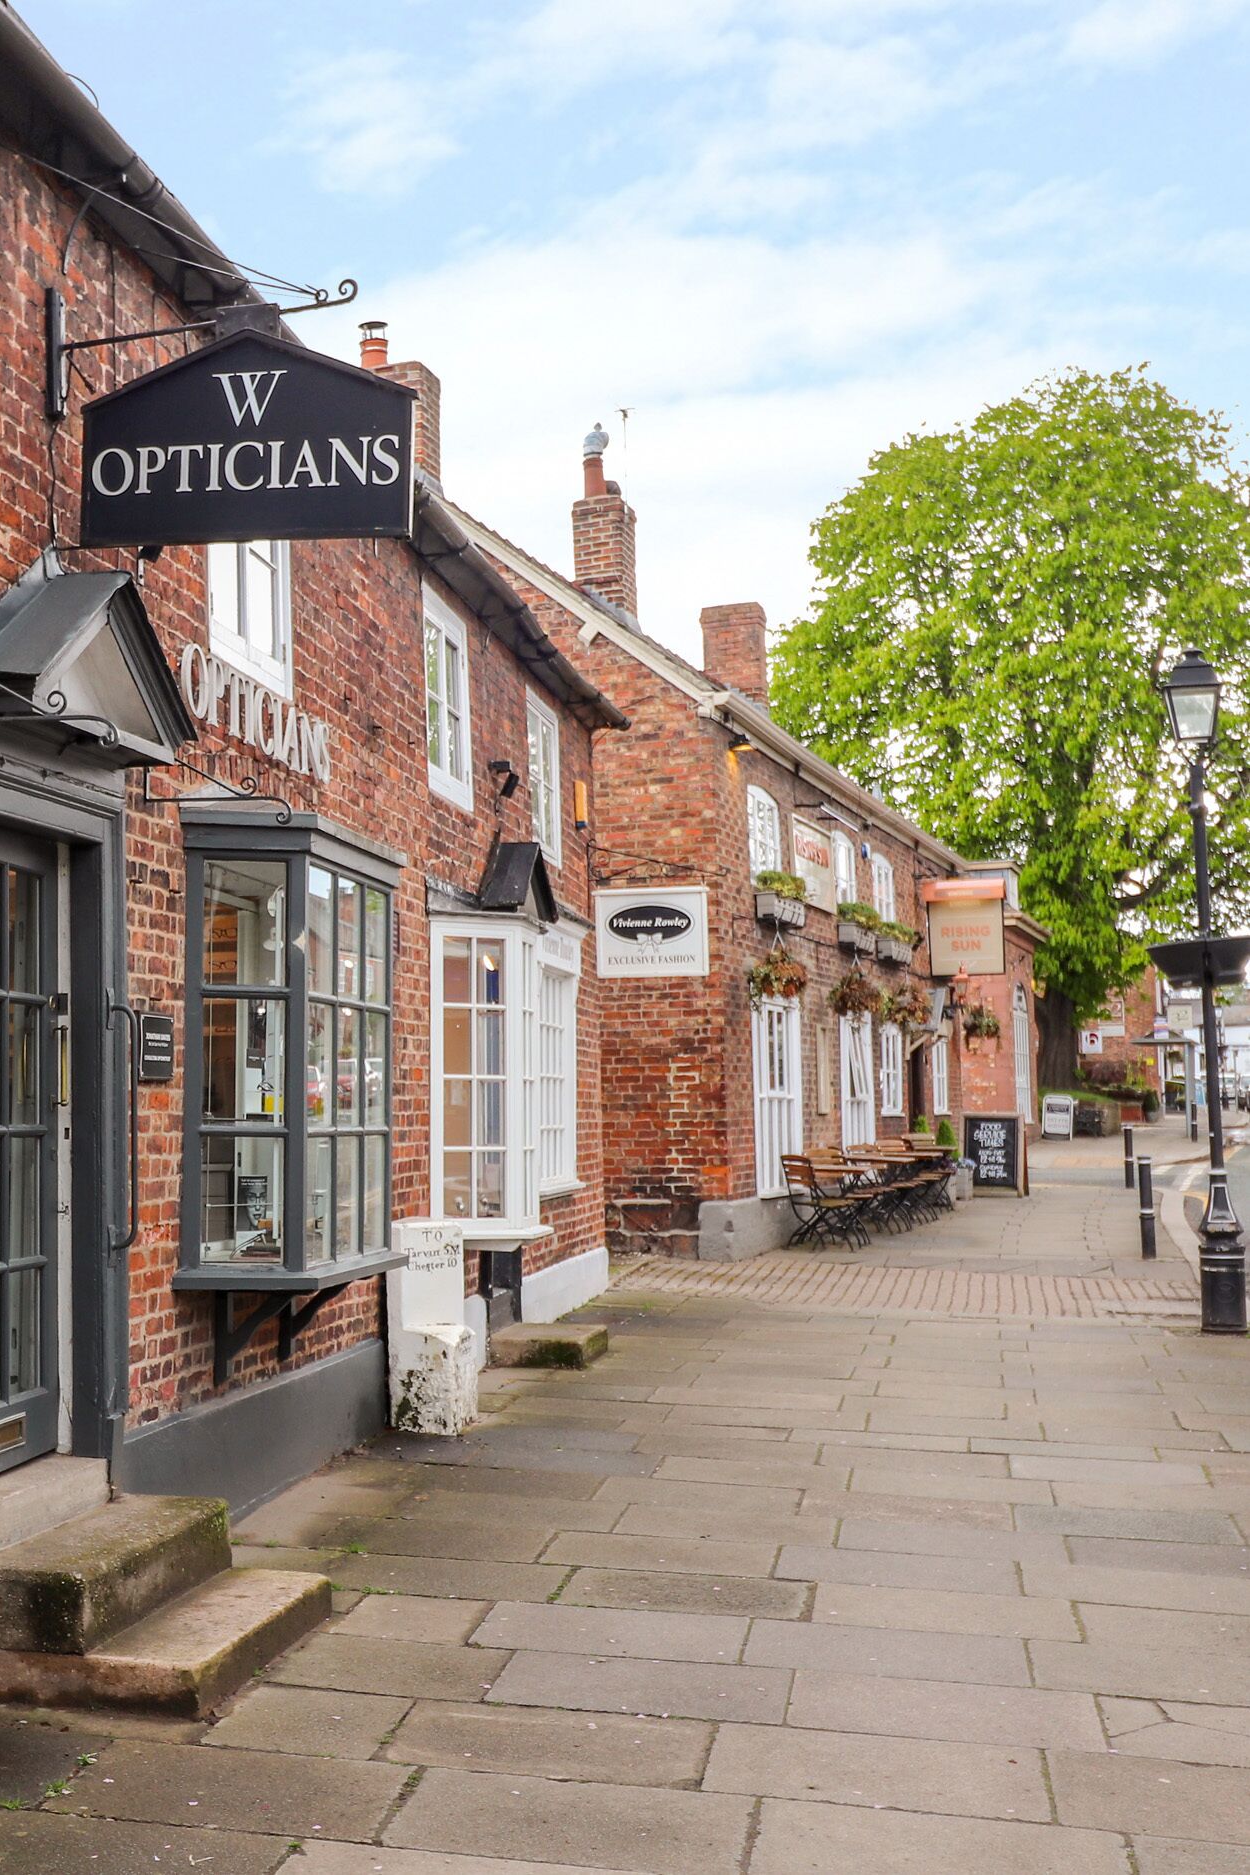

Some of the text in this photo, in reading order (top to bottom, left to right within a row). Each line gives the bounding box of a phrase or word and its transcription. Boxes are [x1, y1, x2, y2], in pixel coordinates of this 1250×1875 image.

[212, 369, 288, 427] W
[91, 434, 400, 497] OPTICIANS
[181, 643, 331, 784] OPTICIANS
[613, 916, 689, 929] Vivienne Rowley
[941, 925, 991, 938] RISING
[951, 939, 982, 952] SUN
[608, 954, 696, 966] EXCLUSIVE FASHION
[980, 1122, 1002, 1131] FOOD
[422, 1230, 443, 1242] TO
[404, 1247, 440, 1258] Tarvin
[447, 1258, 458, 1268] 10
